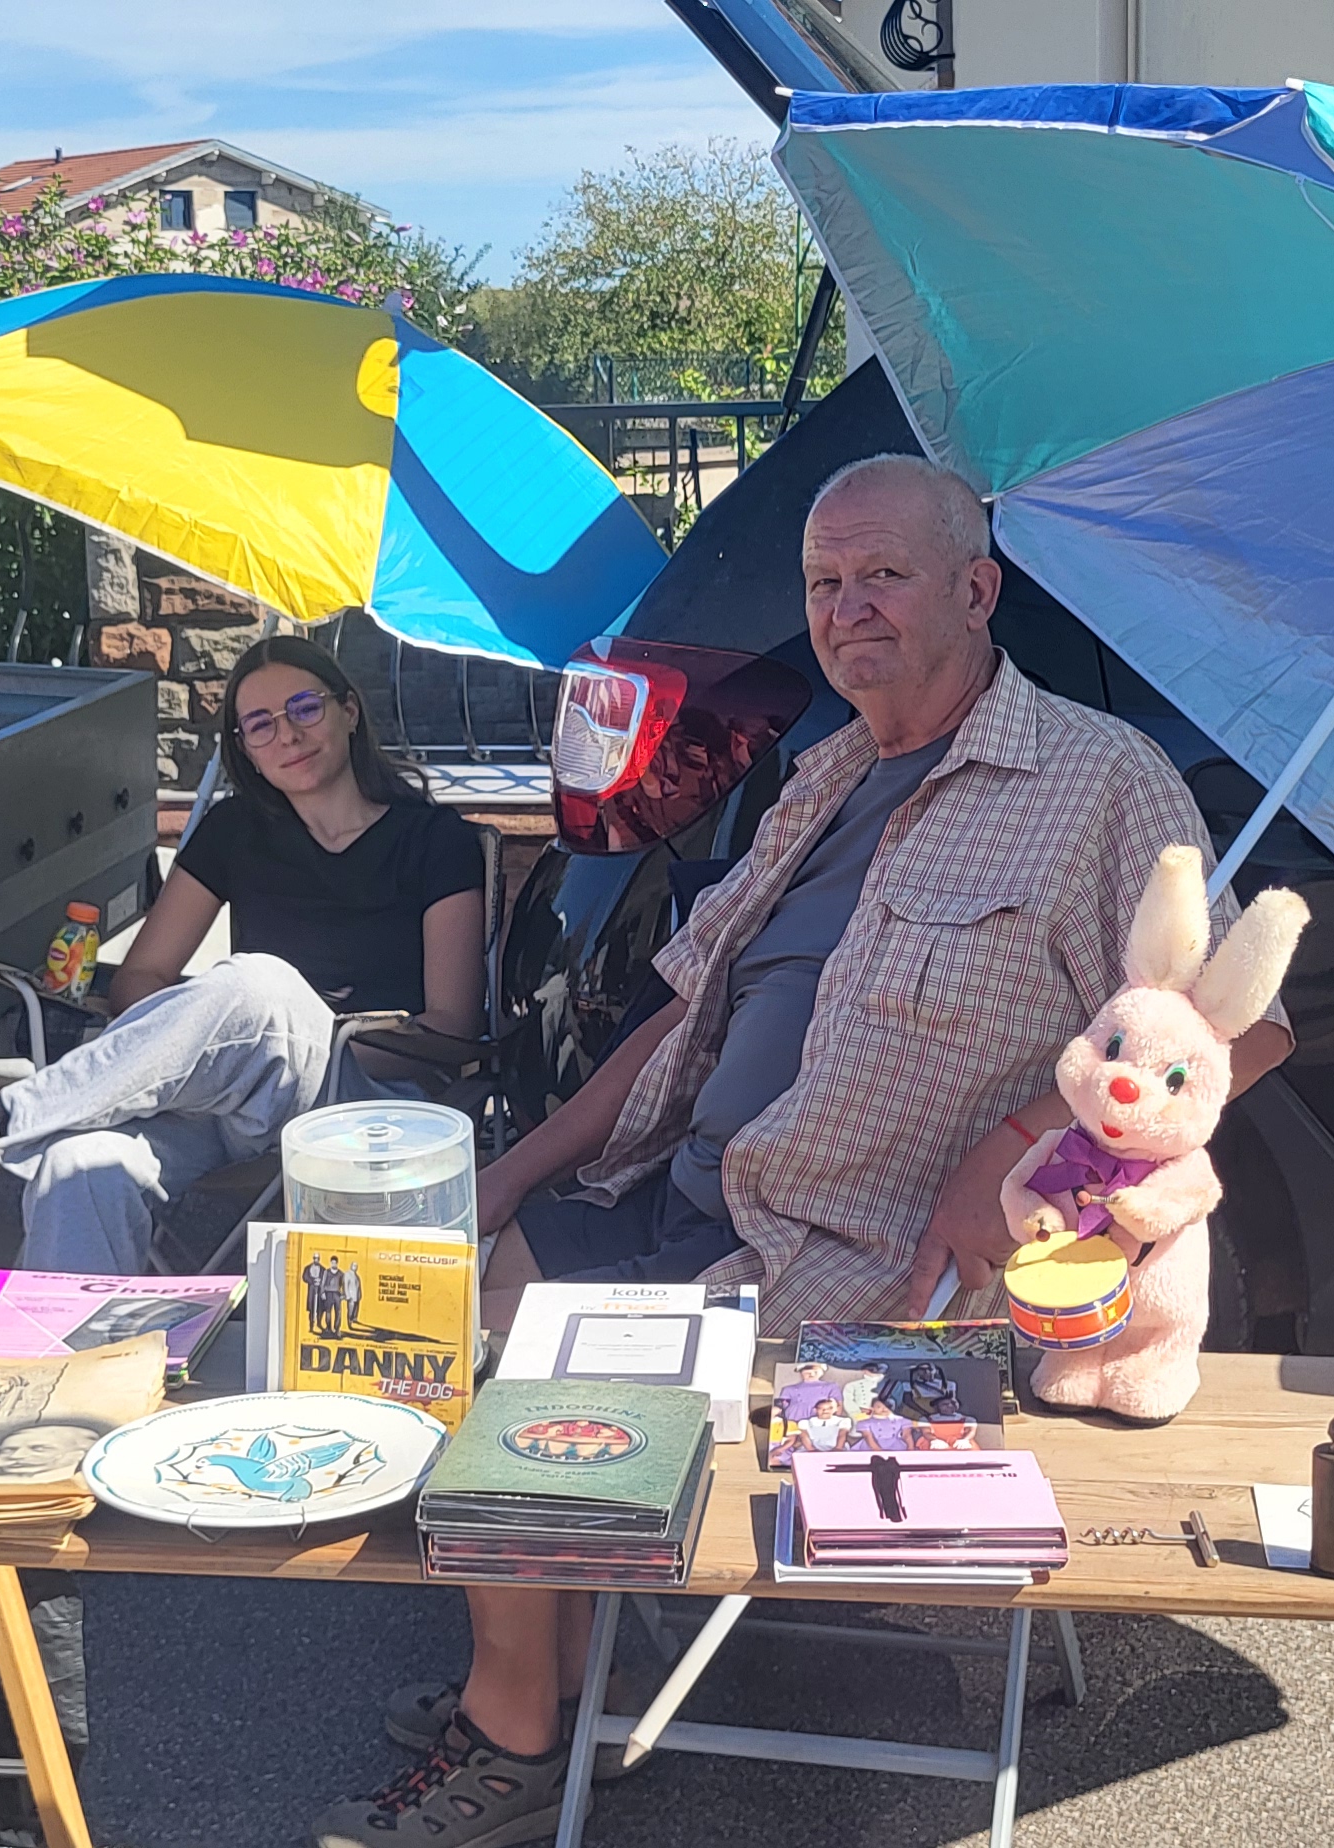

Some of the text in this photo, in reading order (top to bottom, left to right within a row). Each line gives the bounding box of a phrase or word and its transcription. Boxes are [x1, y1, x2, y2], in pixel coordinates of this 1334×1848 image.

[404, 1254, 458, 1266] EXCLUSIF
[612, 1288, 668, 1297] kobo
[299, 1343, 456, 1383] DANNY
[380, 1378, 454, 1399] THE DOG
[524, 1404, 647, 1420] INDOCHINE
